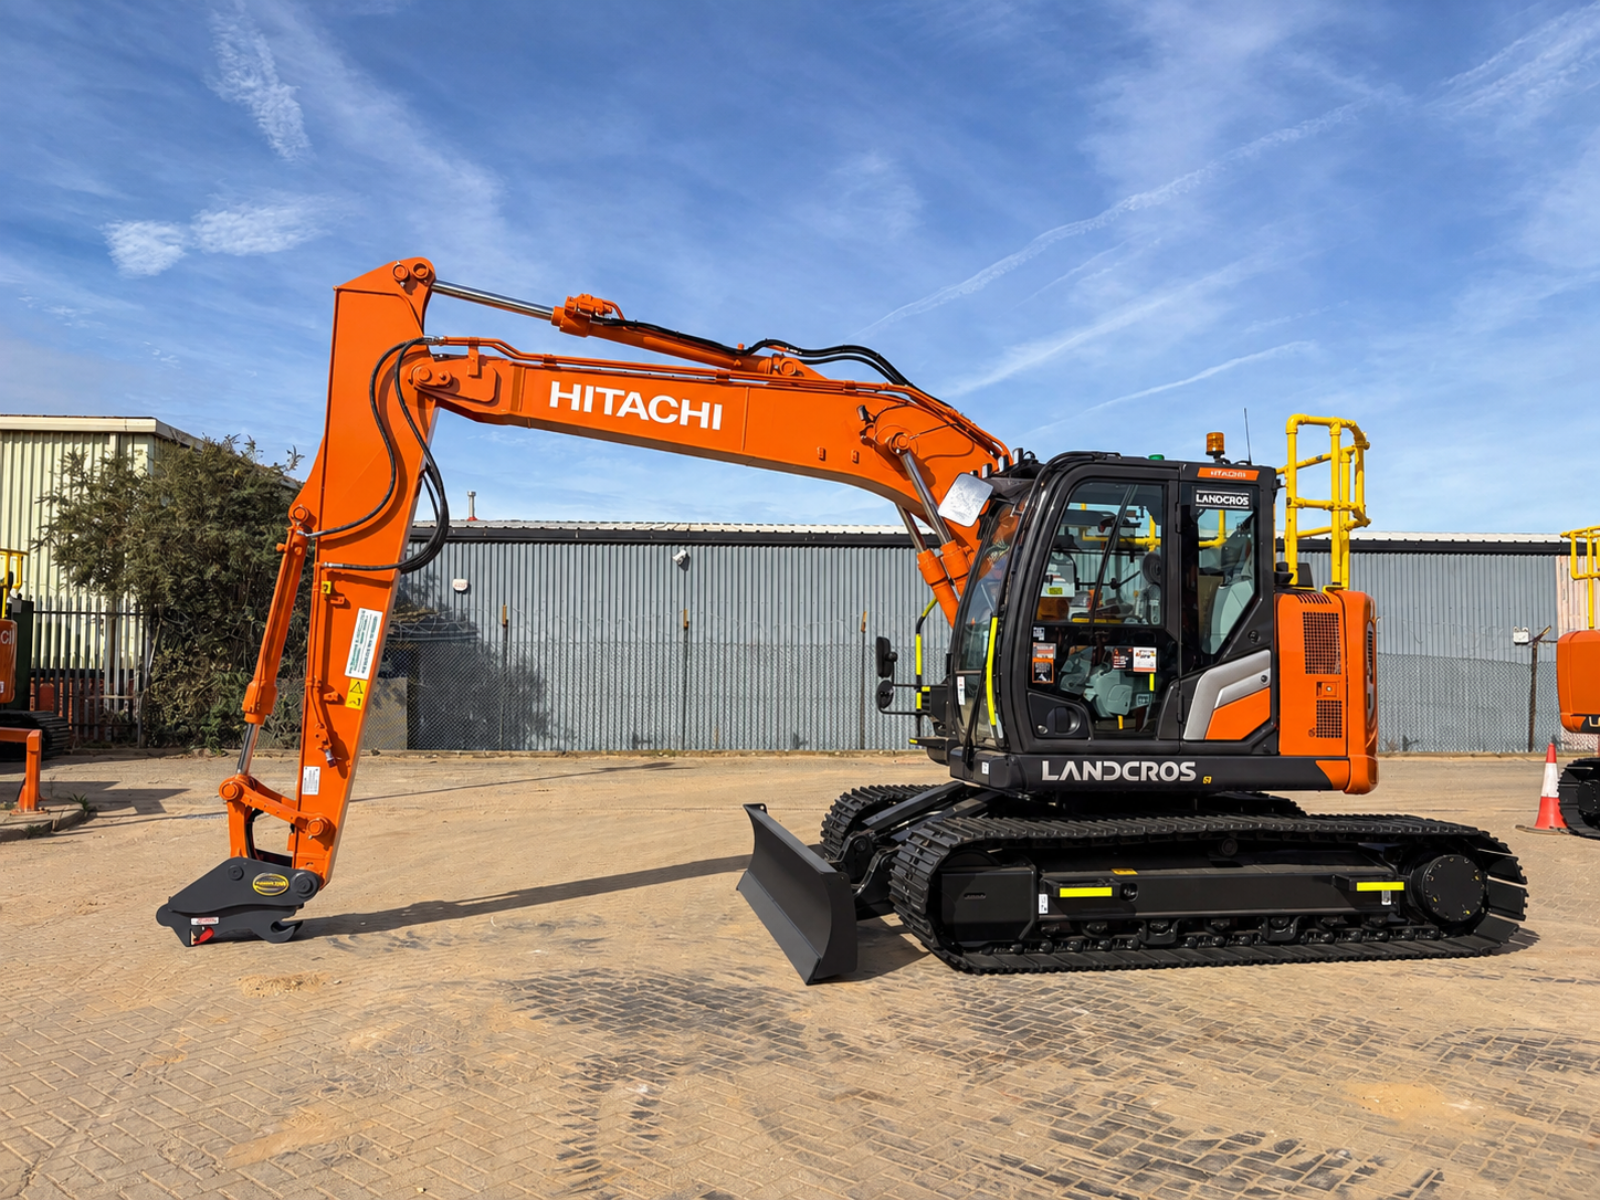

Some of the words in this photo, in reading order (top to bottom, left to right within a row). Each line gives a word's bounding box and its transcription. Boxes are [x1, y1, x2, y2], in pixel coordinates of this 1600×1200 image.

[549, 381, 722, 431] HITACHI
[1211, 470, 1246, 478] HITACHI
[1195, 493, 1249, 506] LANDCROS
[1041, 760, 1197, 782] LANDCROS
